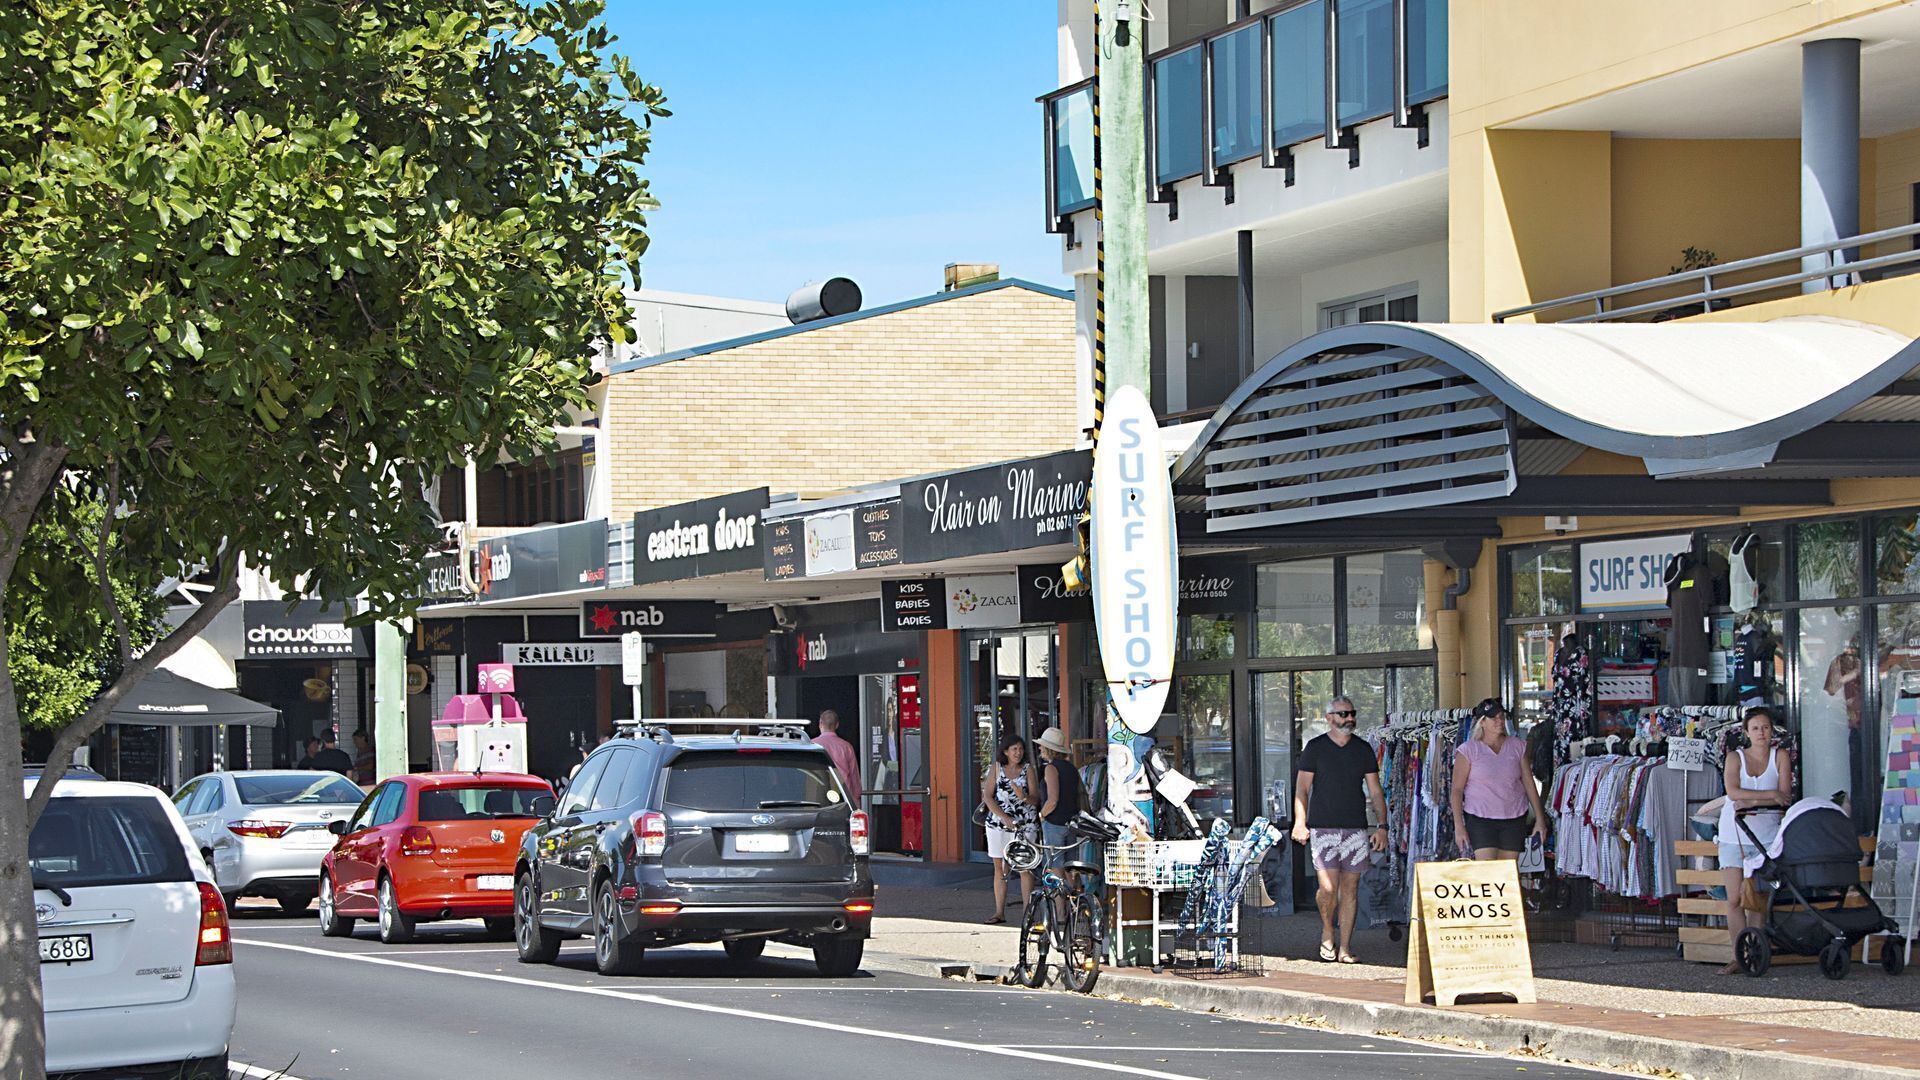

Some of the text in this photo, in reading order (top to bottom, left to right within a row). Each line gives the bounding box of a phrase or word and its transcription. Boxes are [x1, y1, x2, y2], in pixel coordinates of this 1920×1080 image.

[1119, 418, 1145, 552] SURF
[925, 467, 1086, 533] Hair on Marine
[863, 509, 890, 523] CLOTHES
[1036, 521, 1045, 536] ph
[1046, 518, 1055, 532] 02
[1056, 514, 1072, 530] 6674
[647, 507, 756, 561] eastern door
[868, 530, 886, 542] TOYS
[491, 544, 511, 581] nab
[860, 548, 898, 563] ACCESSORIES
[428, 565, 461, 593] HE GALLE
[775, 564, 795, 576] LADIES
[1589, 556, 1634, 592] SURF
[900, 583, 924, 593] KIDS
[895, 599, 930, 609] BABIES
[620, 605, 665, 626] nab
[897, 615, 932, 626] LADIES
[1123, 569, 1151, 701] SHOP
[249, 645, 353, 654] ESPRESSO BAR
[808, 633, 827, 661] nab
[1434, 883, 1506, 899] OXLEY
[1437, 903, 1511, 919] &MOSS
